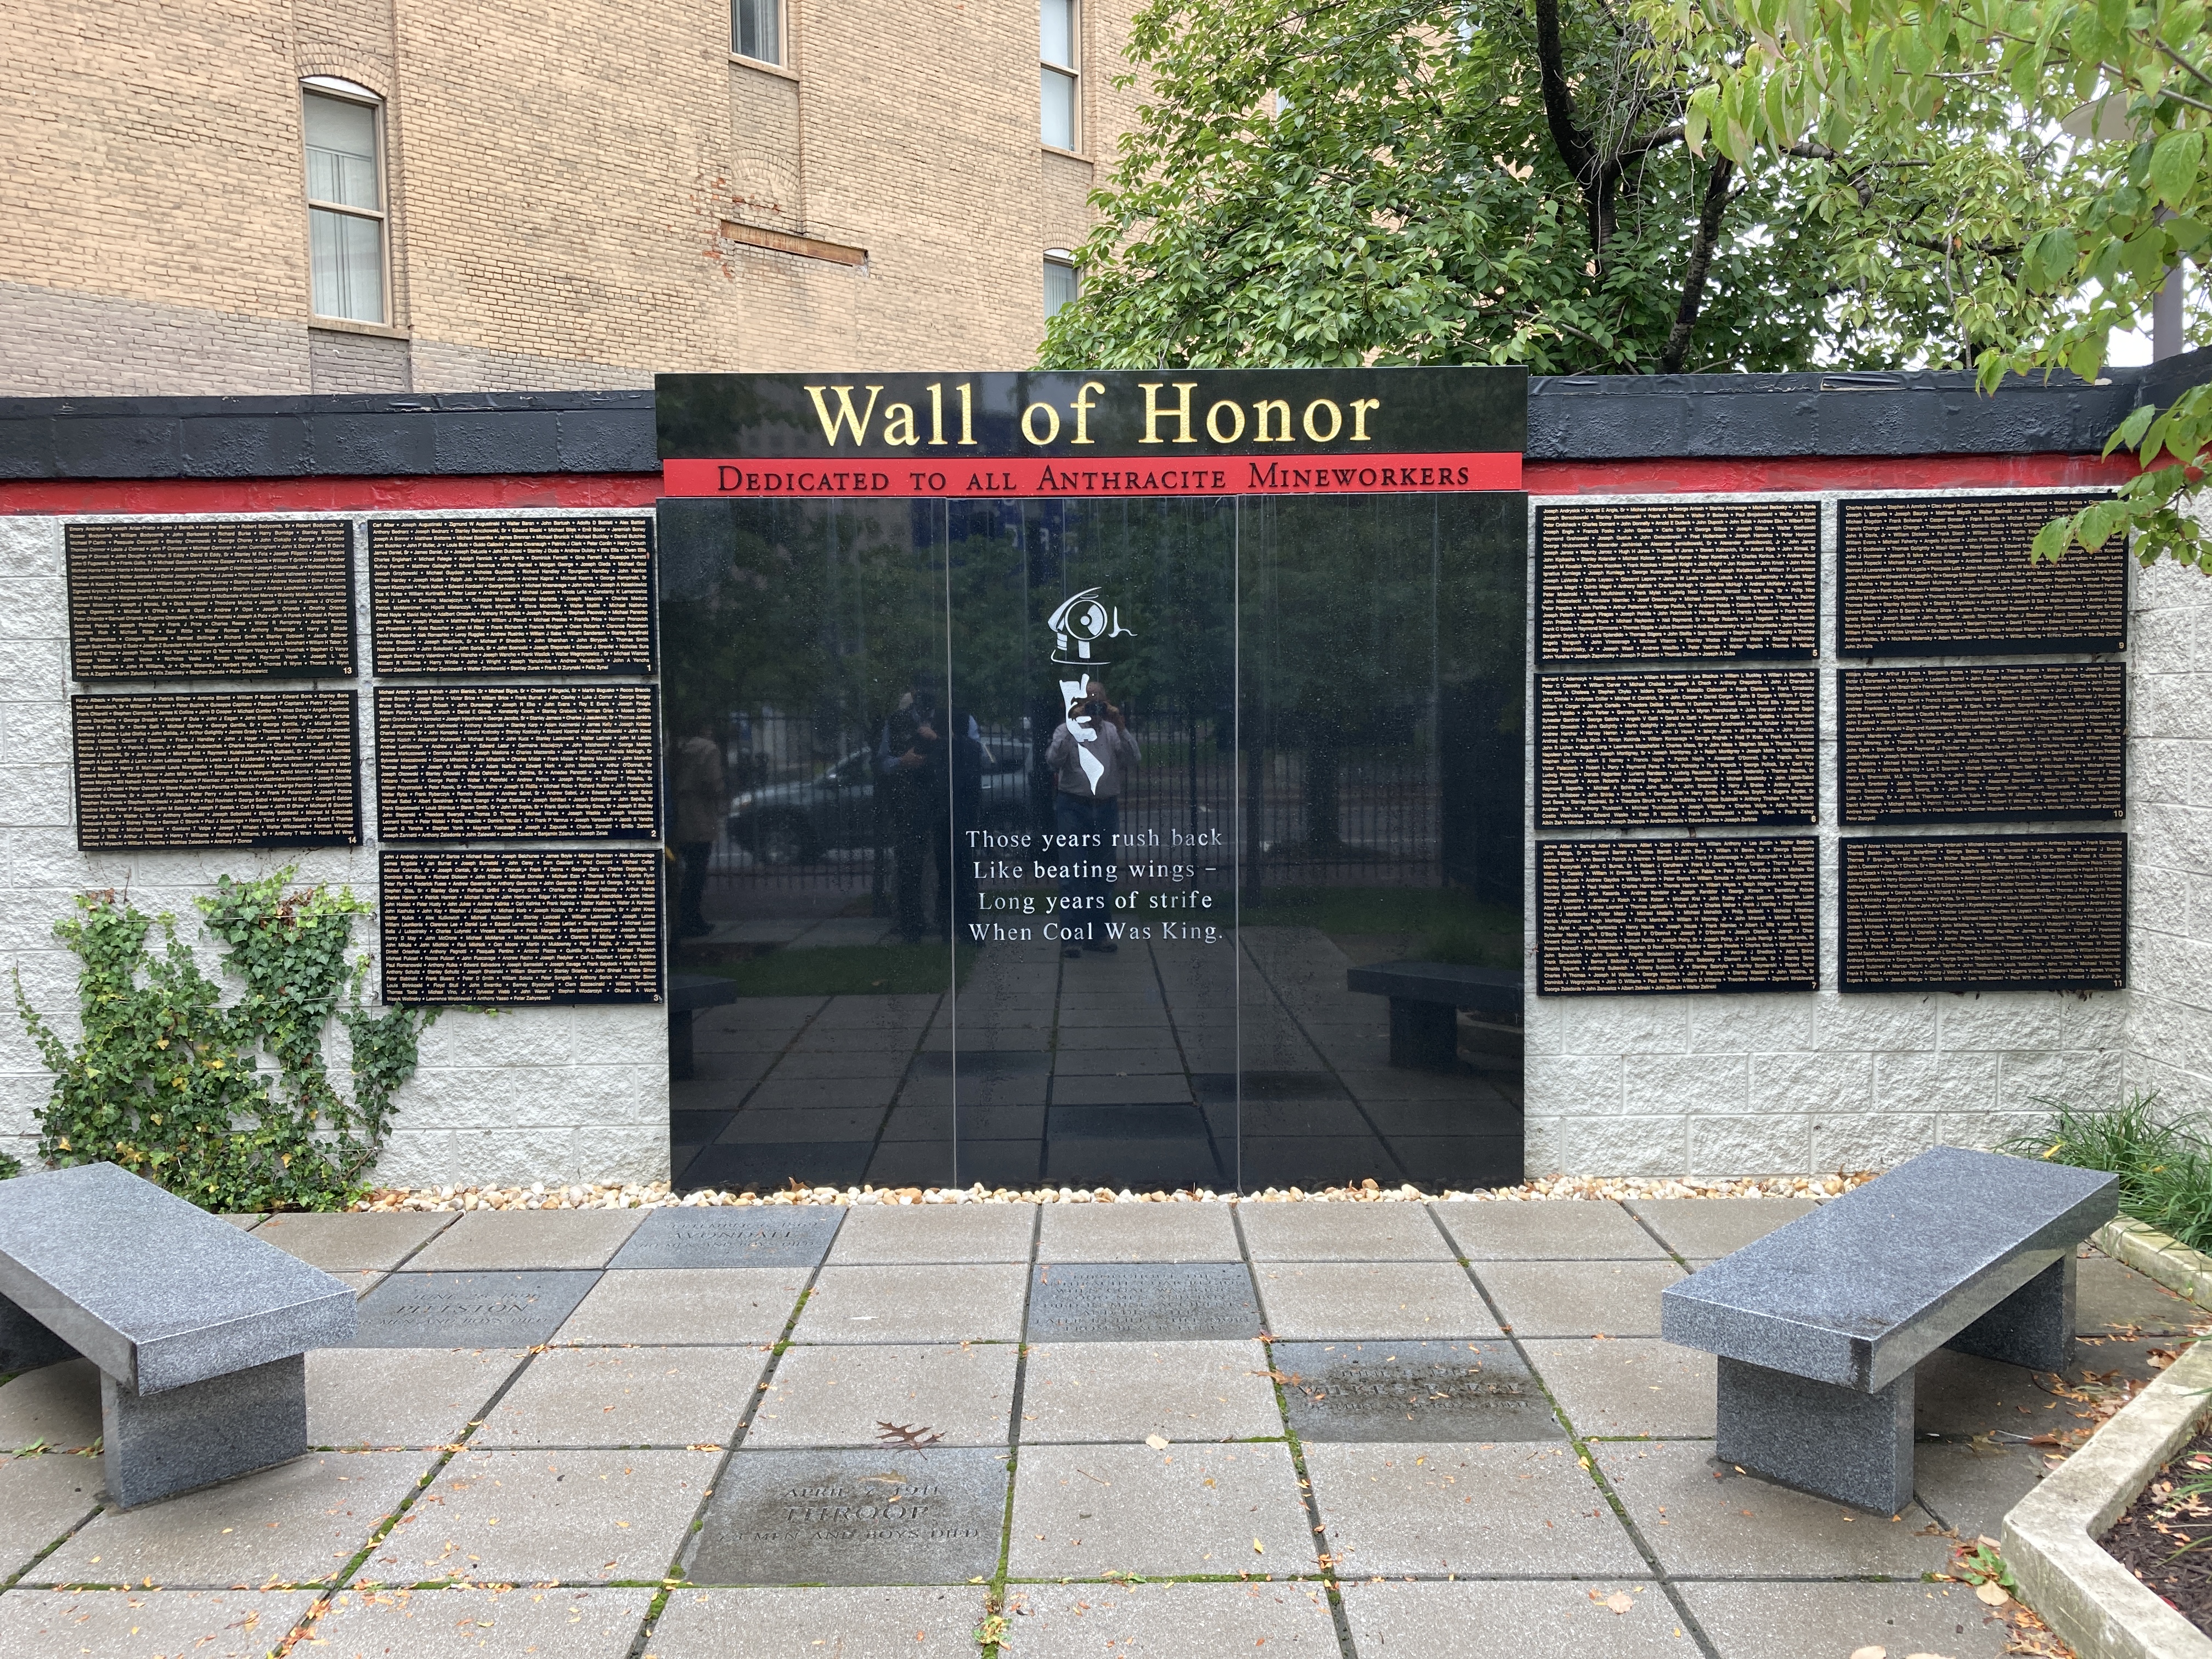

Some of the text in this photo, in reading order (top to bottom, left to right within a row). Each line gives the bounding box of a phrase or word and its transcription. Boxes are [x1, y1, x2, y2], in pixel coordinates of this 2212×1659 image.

[805, 381, 1380, 446] Wall of Honor
[719, 462, 1470, 491] DEDICATED TO ALL ANTHRACITE MINEWORKERS
[966, 828, 1222, 852] Those years rush back
[973, 860, 1023, 878] Like
[1033, 860, 1118, 882] beating
[1128, 860, 1194, 882] wings
[978, 890, 1212, 914] Long years of strife
[968, 922, 1222, 944] When Coal Was King.
[1812, 981, 1817, 989] 7
[396, 1303, 529, 1313] PITTSTON
[783, 1485, 939, 1497] APRIL 7 1911
[783, 1505, 929, 1521] THROOP
[754, 1531, 798, 1541] MEN
[810, 1531, 854, 1540] AND
[866, 1530, 920, 1539] BOYS
[929, 1529, 980, 1538] DIED
